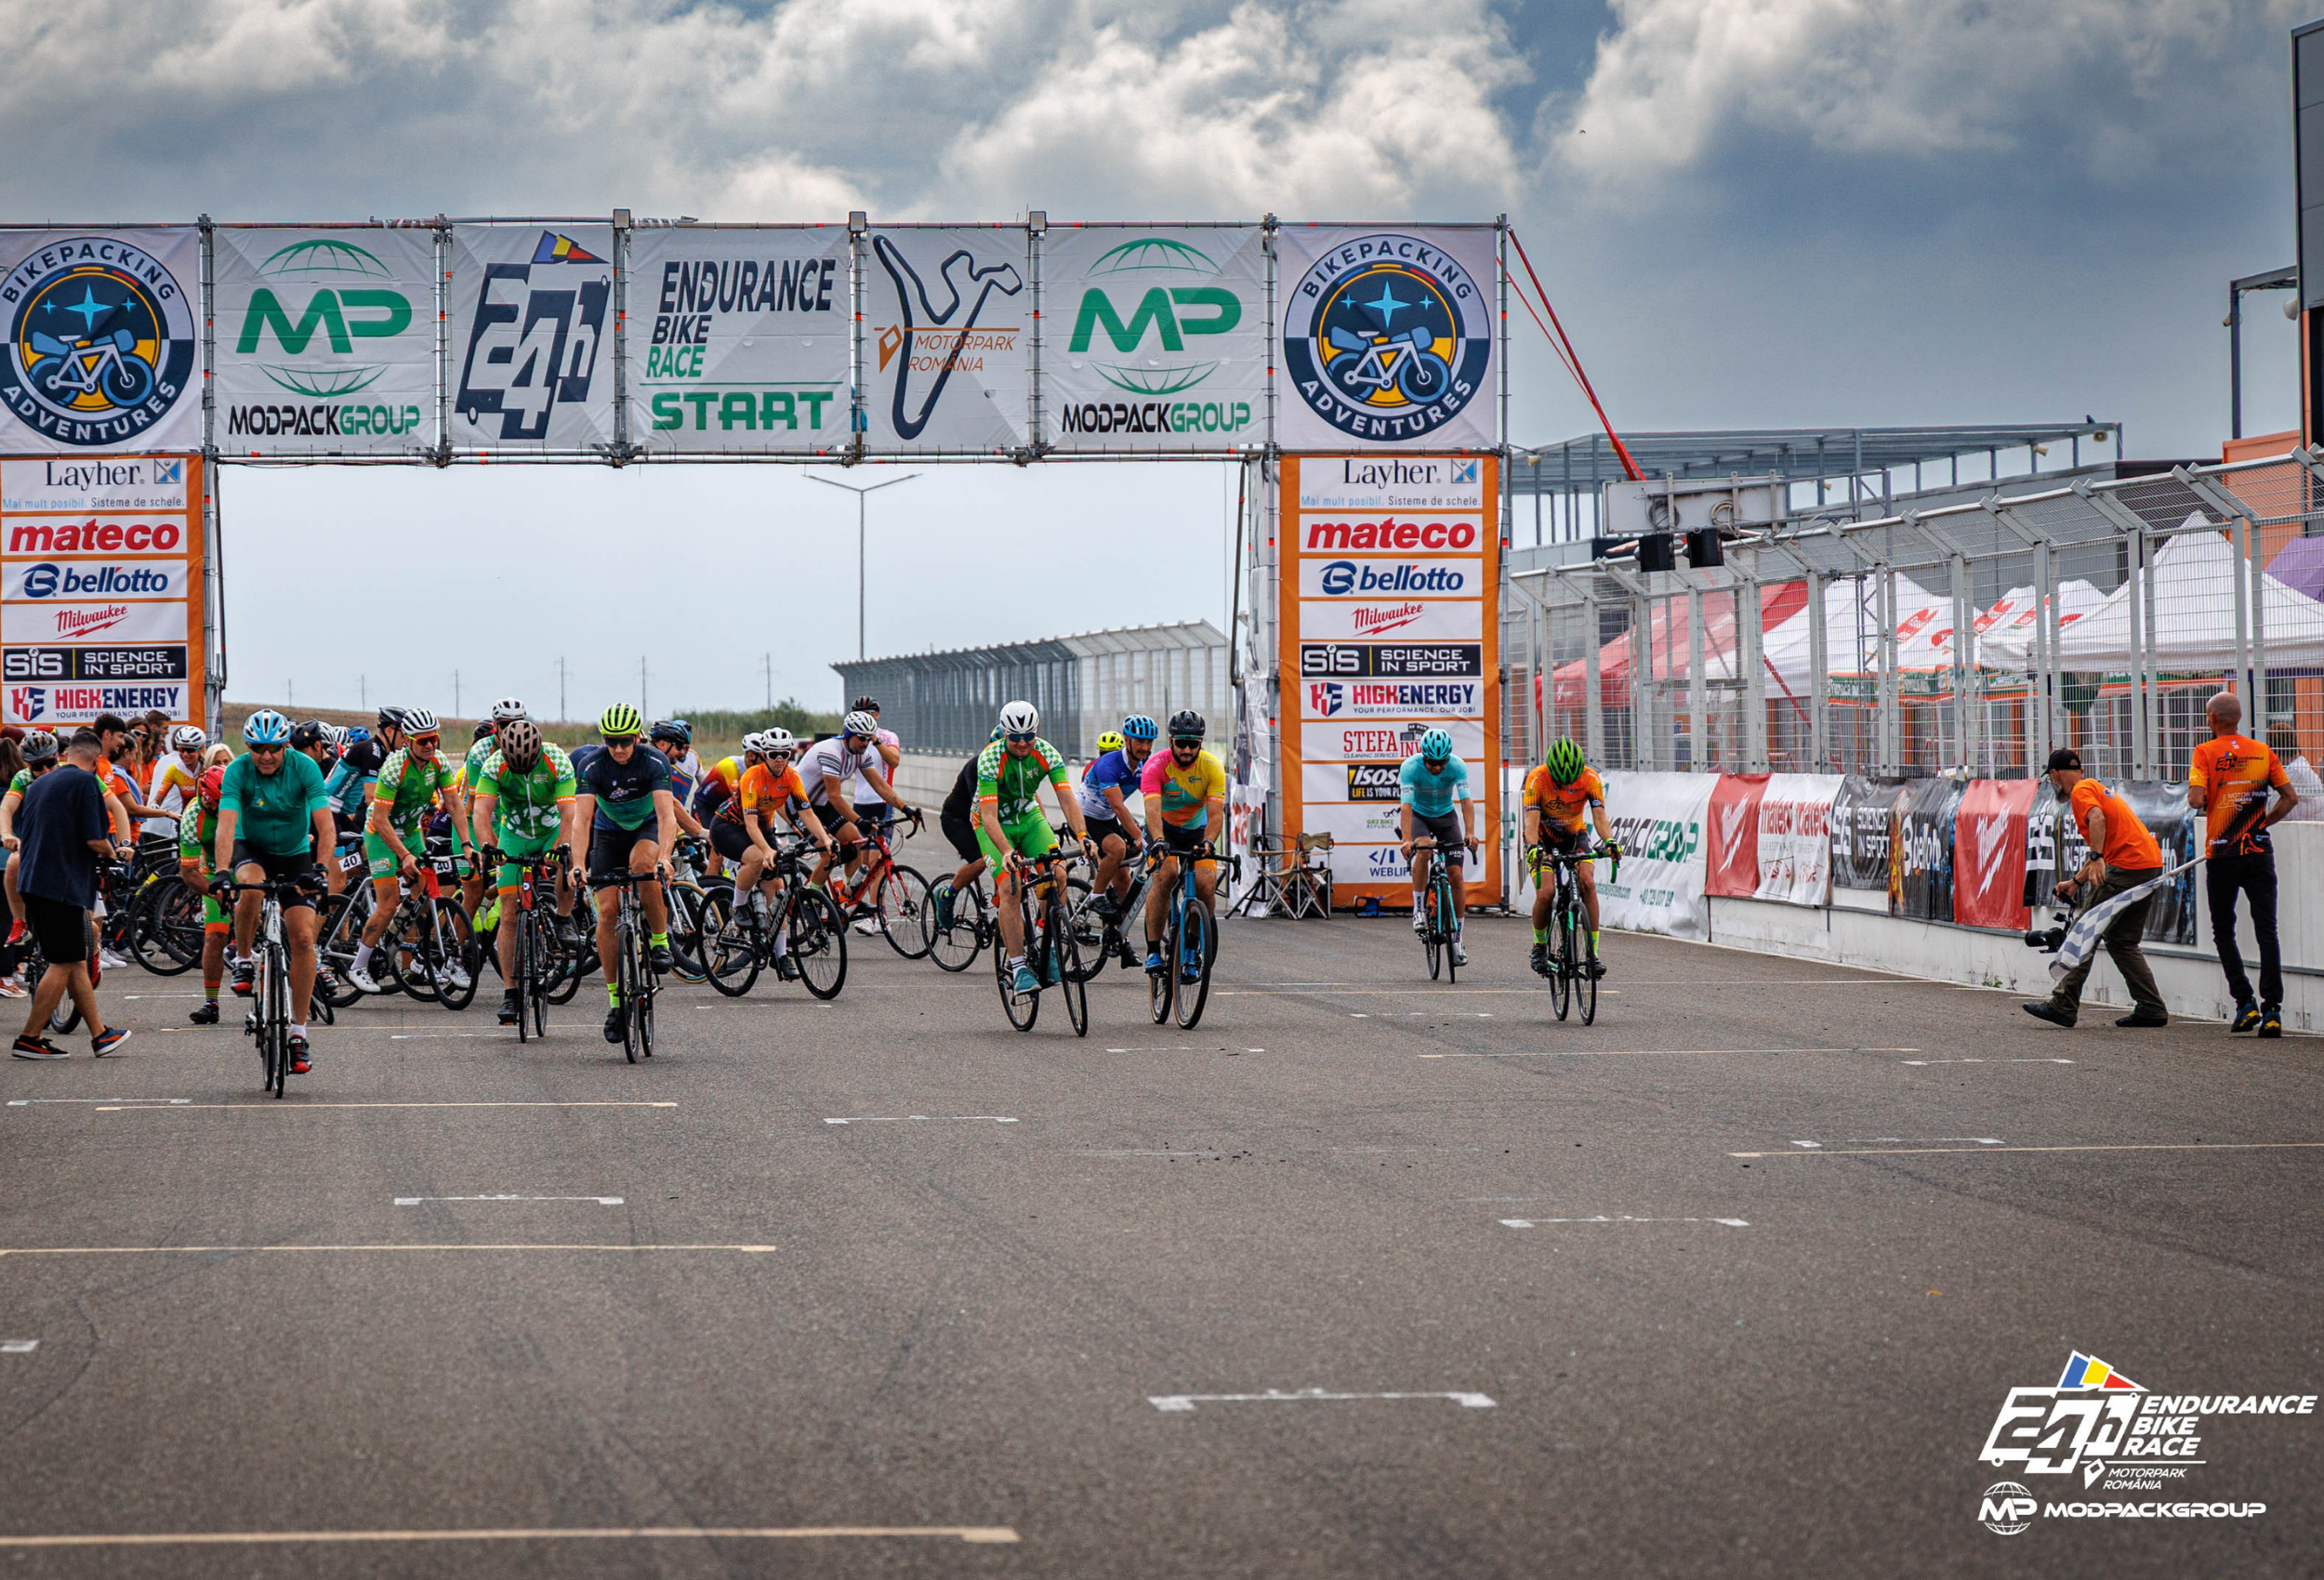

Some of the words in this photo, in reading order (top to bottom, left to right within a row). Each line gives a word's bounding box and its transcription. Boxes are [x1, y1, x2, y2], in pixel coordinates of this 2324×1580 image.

[2, 243, 176, 304] BIKEPACKING
[1303, 239, 1472, 300] BIKEPACKING
[659, 258, 836, 313] ENDURANCE
[236, 288, 412, 354] MP
[652, 315, 712, 345] BIKE
[1067, 287, 1242, 353] MP
[915, 336, 1018, 351] MOTORPARK
[646, 346, 706, 378] RACE
[907, 352, 984, 372] ROMÂNIA
[2, 379, 177, 440] ADVENTURES
[229, 404, 420, 436] MODPACKGROUP
[651, 390, 834, 430] START
[1062, 402, 1250, 434] MODPACKGROUP
[1303, 378, 1471, 437] ADVENTURES
[46, 461, 141, 491] Layher
[1343, 459, 1437, 490] Layher
[3, 499, 20, 508] Mai
[24, 498, 47, 508] mult
[50, 497, 87, 509] posibil.
[91, 497, 130, 507] Sisteme
[134, 497, 146, 507] de
[150, 497, 185, 507] schele.
[1301, 496, 1319, 506] Mai
[1323, 496, 1345, 506] mult
[1348, 496, 1385, 507] posibil.
[1388, 496, 1427, 506] Sisteme
[1431, 496, 1443, 506] de
[1446, 496, 1481, 506] schele.
[8, 519, 179, 551] mateco
[1307, 517, 1475, 548] mateco
[61, 566, 168, 593] bellotto
[1359, 565, 1464, 591] bellotto
[54, 604, 128, 632] Milwaukee
[1351, 602, 1424, 629] Milwaukee
[84, 652, 167, 663] SCIENCE
[85, 664, 106, 675] IN
[110, 663, 176, 675] SPORT
[1380, 650, 1463, 660] SCIENCE
[1381, 661, 1402, 672] IN
[1406, 661, 1471, 672] SPORT
[1343, 731, 1399, 753] STEFA
[1400, 742, 1422, 757] INV
[1352, 787, 1366, 798] LIFE
[1367, 787, 1373, 797] IS
[1375, 787, 1391, 797] YOUR
[1393, 786, 1401, 797] PL
[343, 854, 358, 868] 40
[436, 862, 450, 871] 40
